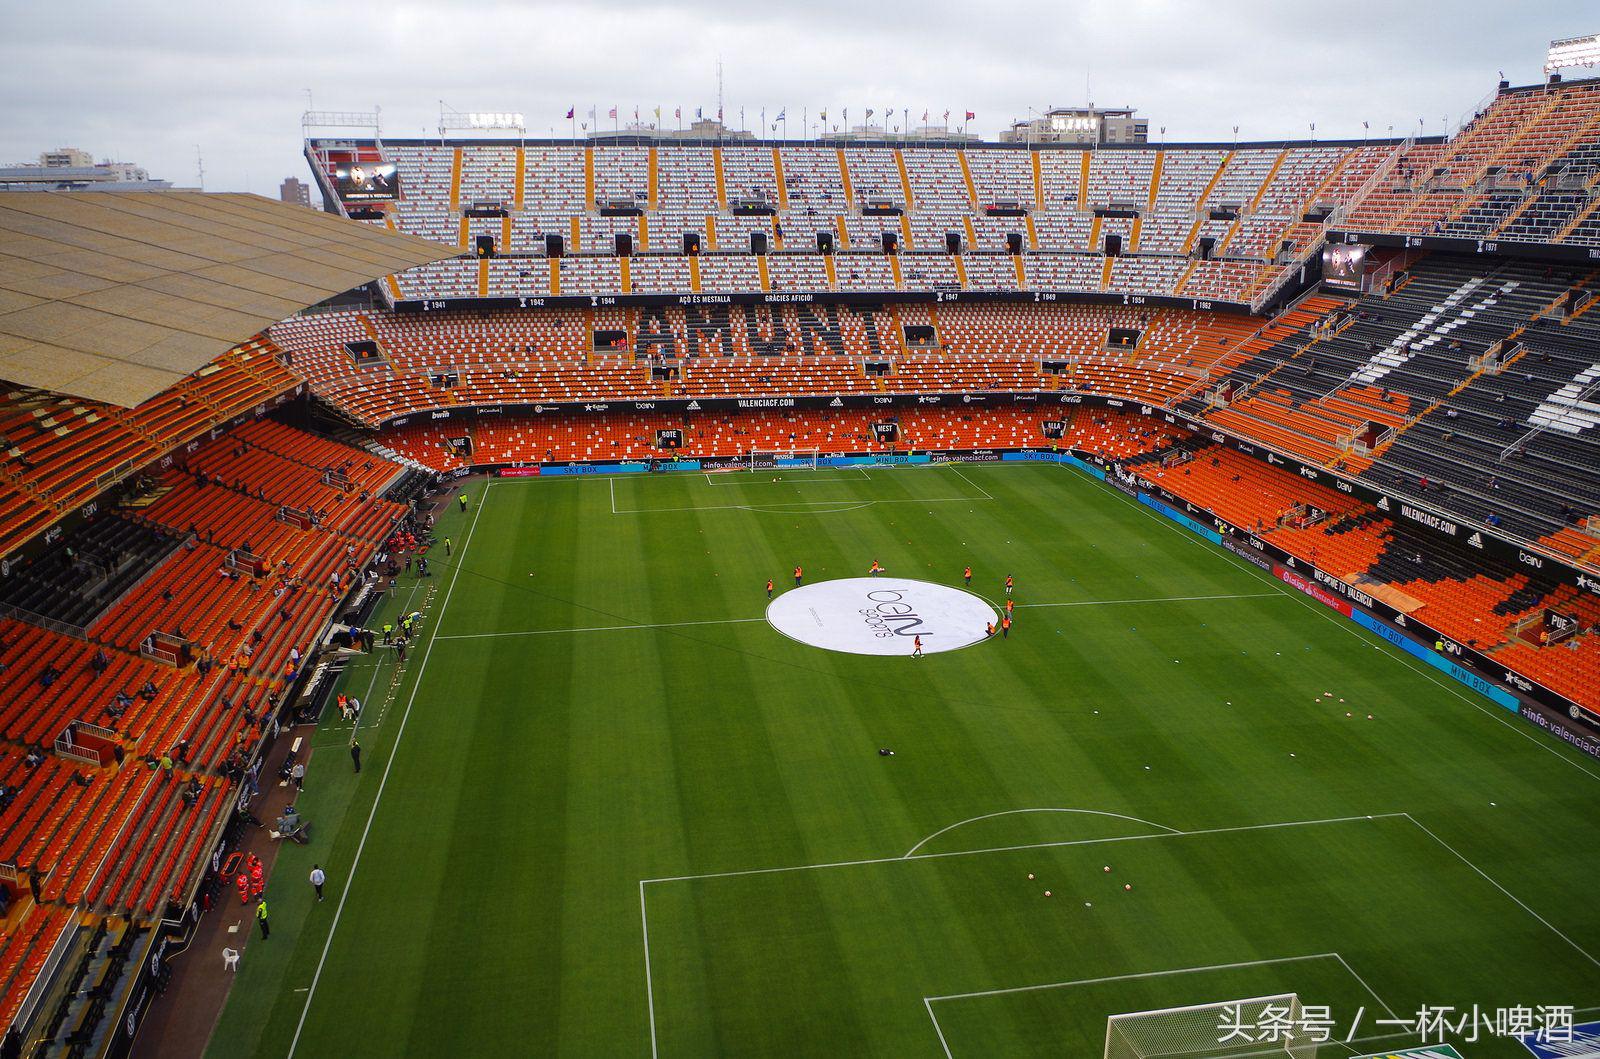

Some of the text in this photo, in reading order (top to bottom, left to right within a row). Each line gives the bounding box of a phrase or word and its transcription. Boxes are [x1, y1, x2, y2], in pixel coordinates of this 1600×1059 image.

[530, 298, 545, 307] 1942
[601, 297, 615, 305] 1944
[702, 295, 731, 304] MESTALLA
[431, 301, 446, 309] 1941
[738, 398, 795, 408] VALENCIACF.COM
[661, 430, 677, 438] BOTE
[452, 438, 465, 446] QUE
[1040, 453, 1055, 461] BOX
[1401, 504, 1457, 536] VALENCIACF.COM
[1347, 586, 1373, 609] VALENCIA
[1551, 614, 1568, 631] PUE
[1371, 620, 1404, 647] SKY BOX
[1450, 664, 1491, 696] MINI BOX
[1521, 707, 1548, 728] +info:
